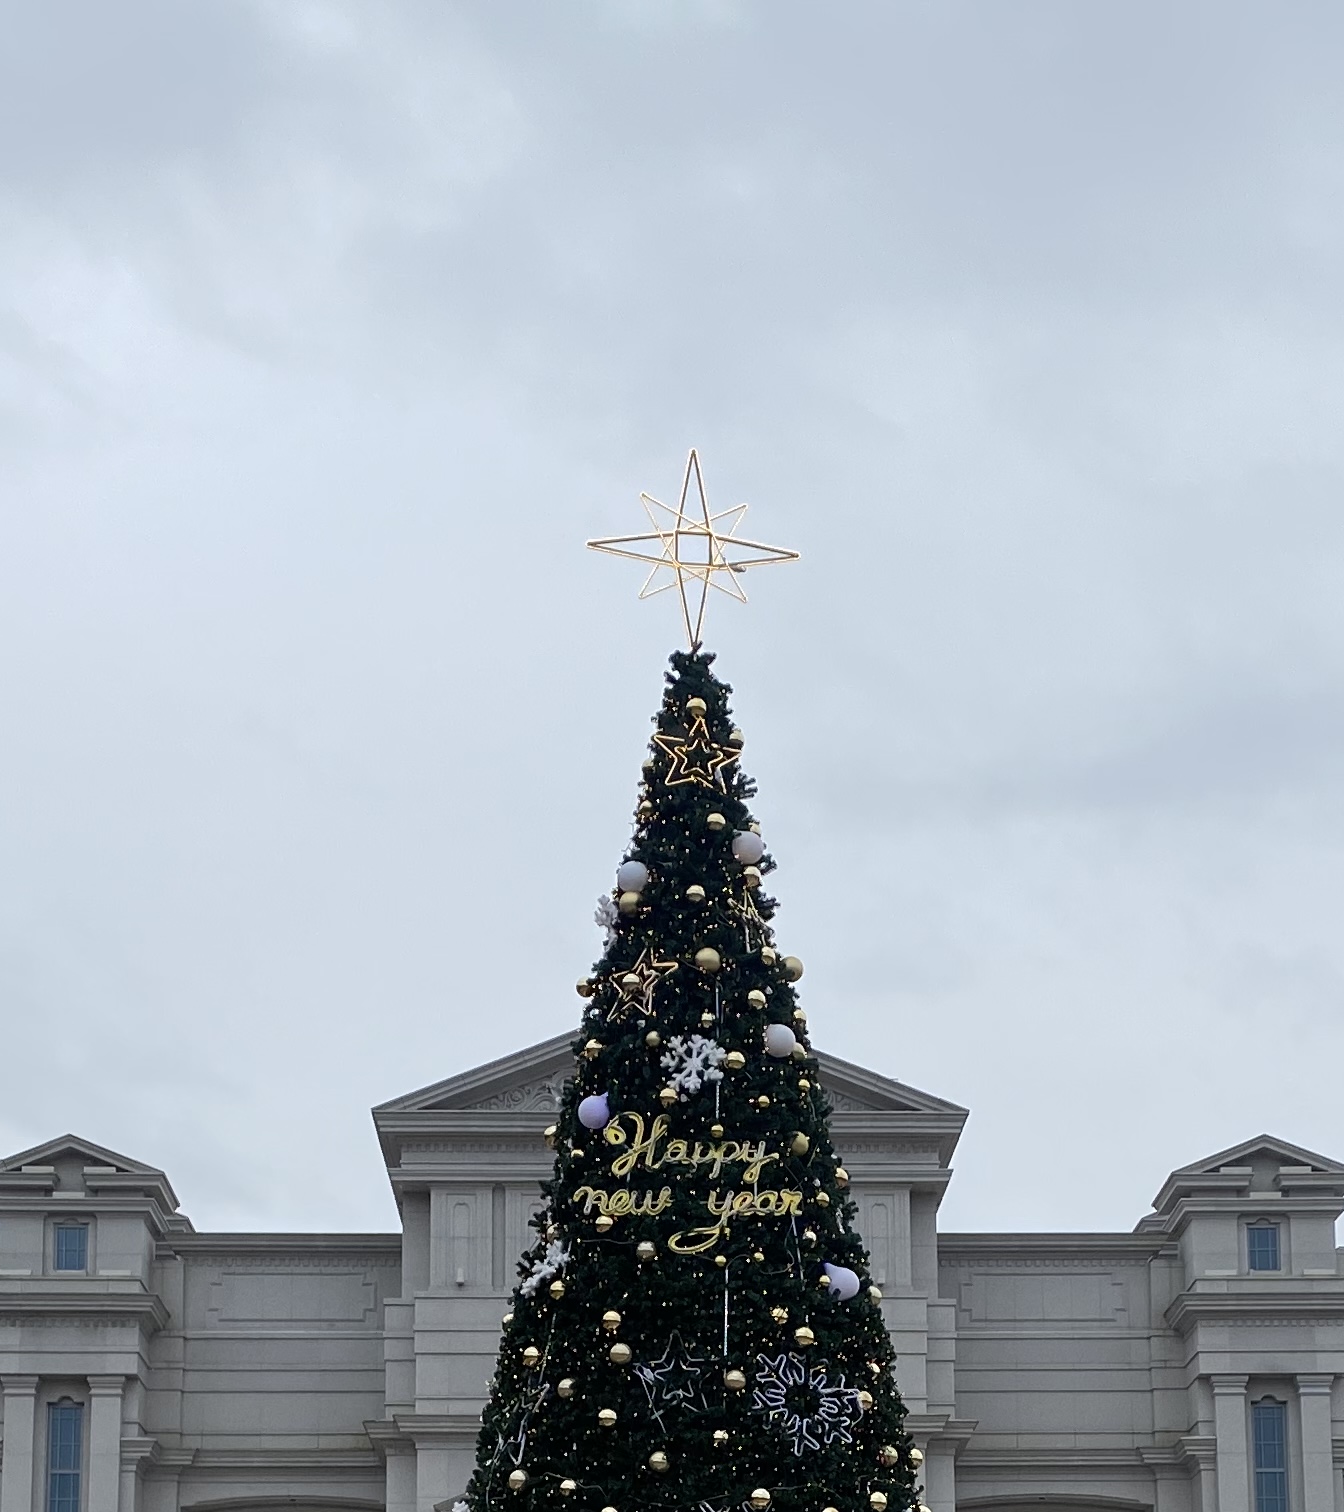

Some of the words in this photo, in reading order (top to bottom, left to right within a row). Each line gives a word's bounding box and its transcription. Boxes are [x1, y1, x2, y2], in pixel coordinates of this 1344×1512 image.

[603, 1111, 779, 1184] Happy
[573, 1186, 675, 1216] new
[667, 1189, 803, 1255] year
